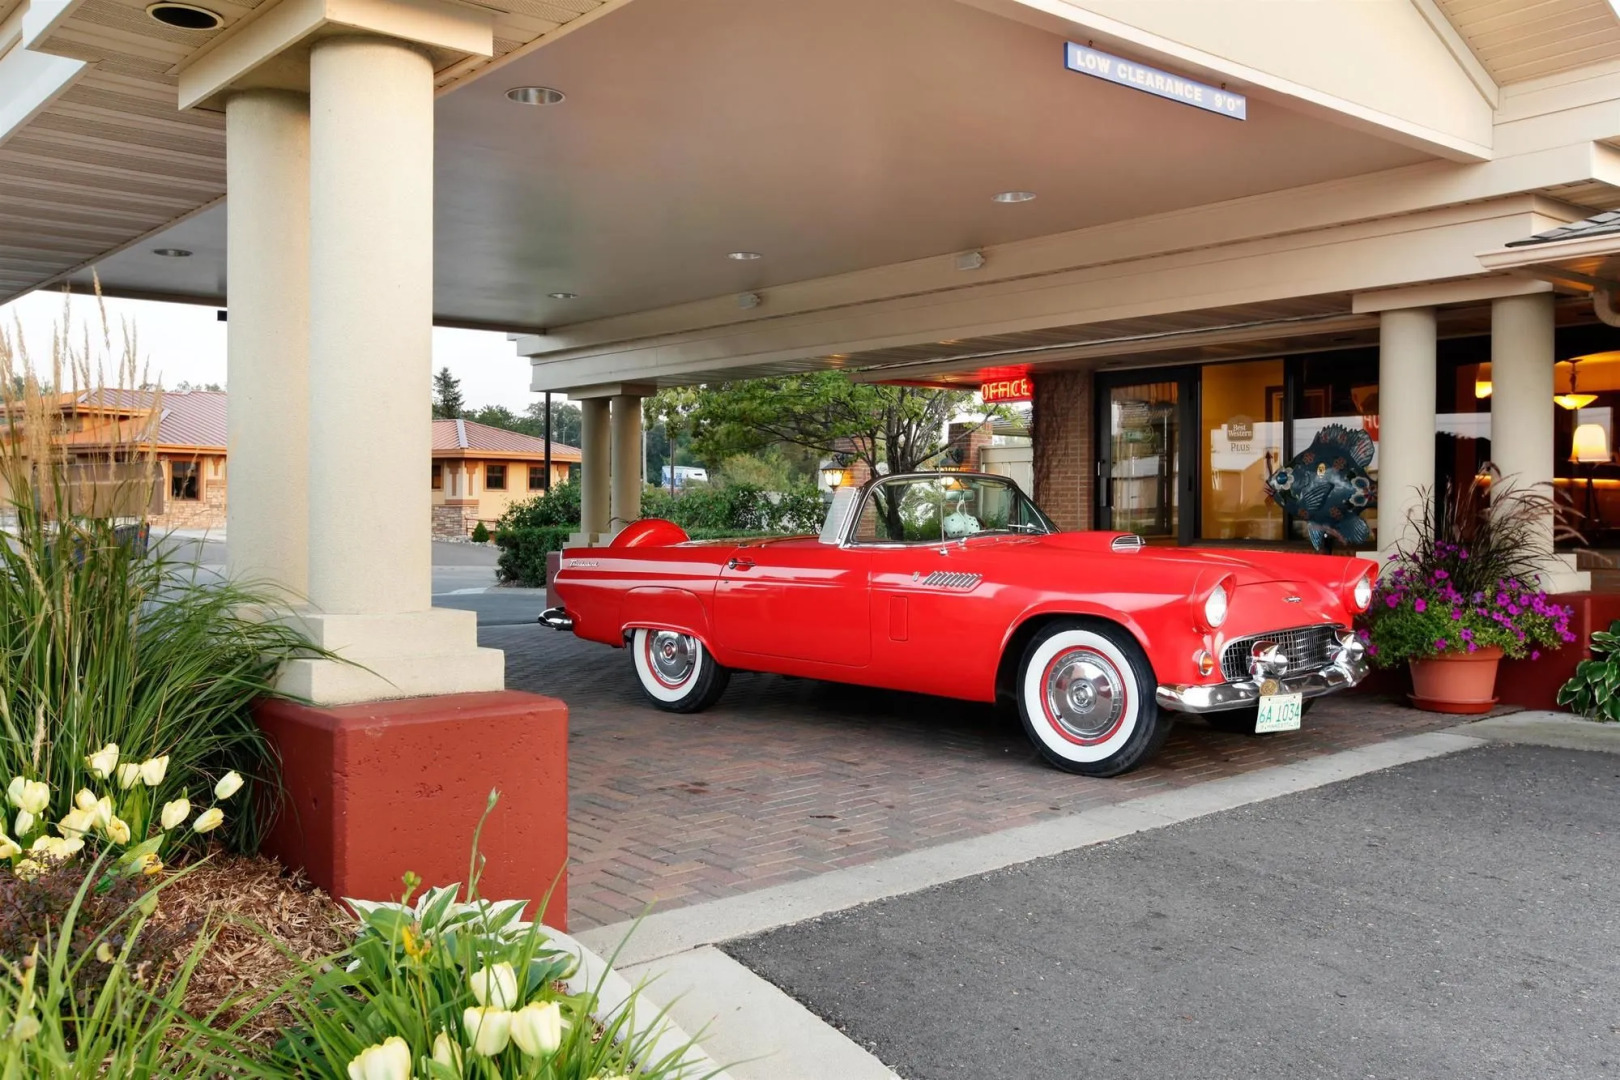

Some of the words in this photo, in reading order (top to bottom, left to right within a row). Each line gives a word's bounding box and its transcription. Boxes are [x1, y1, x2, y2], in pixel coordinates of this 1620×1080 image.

[1076, 51, 1111, 74] LOW
[1117, 63, 1203, 102] CLEARANCE
[981, 378, 1031, 400] OFFICE
[1233, 424, 1246, 432] Best
[1259, 705, 1272, 723] 6A
[1276, 702, 1300, 722] 1034
